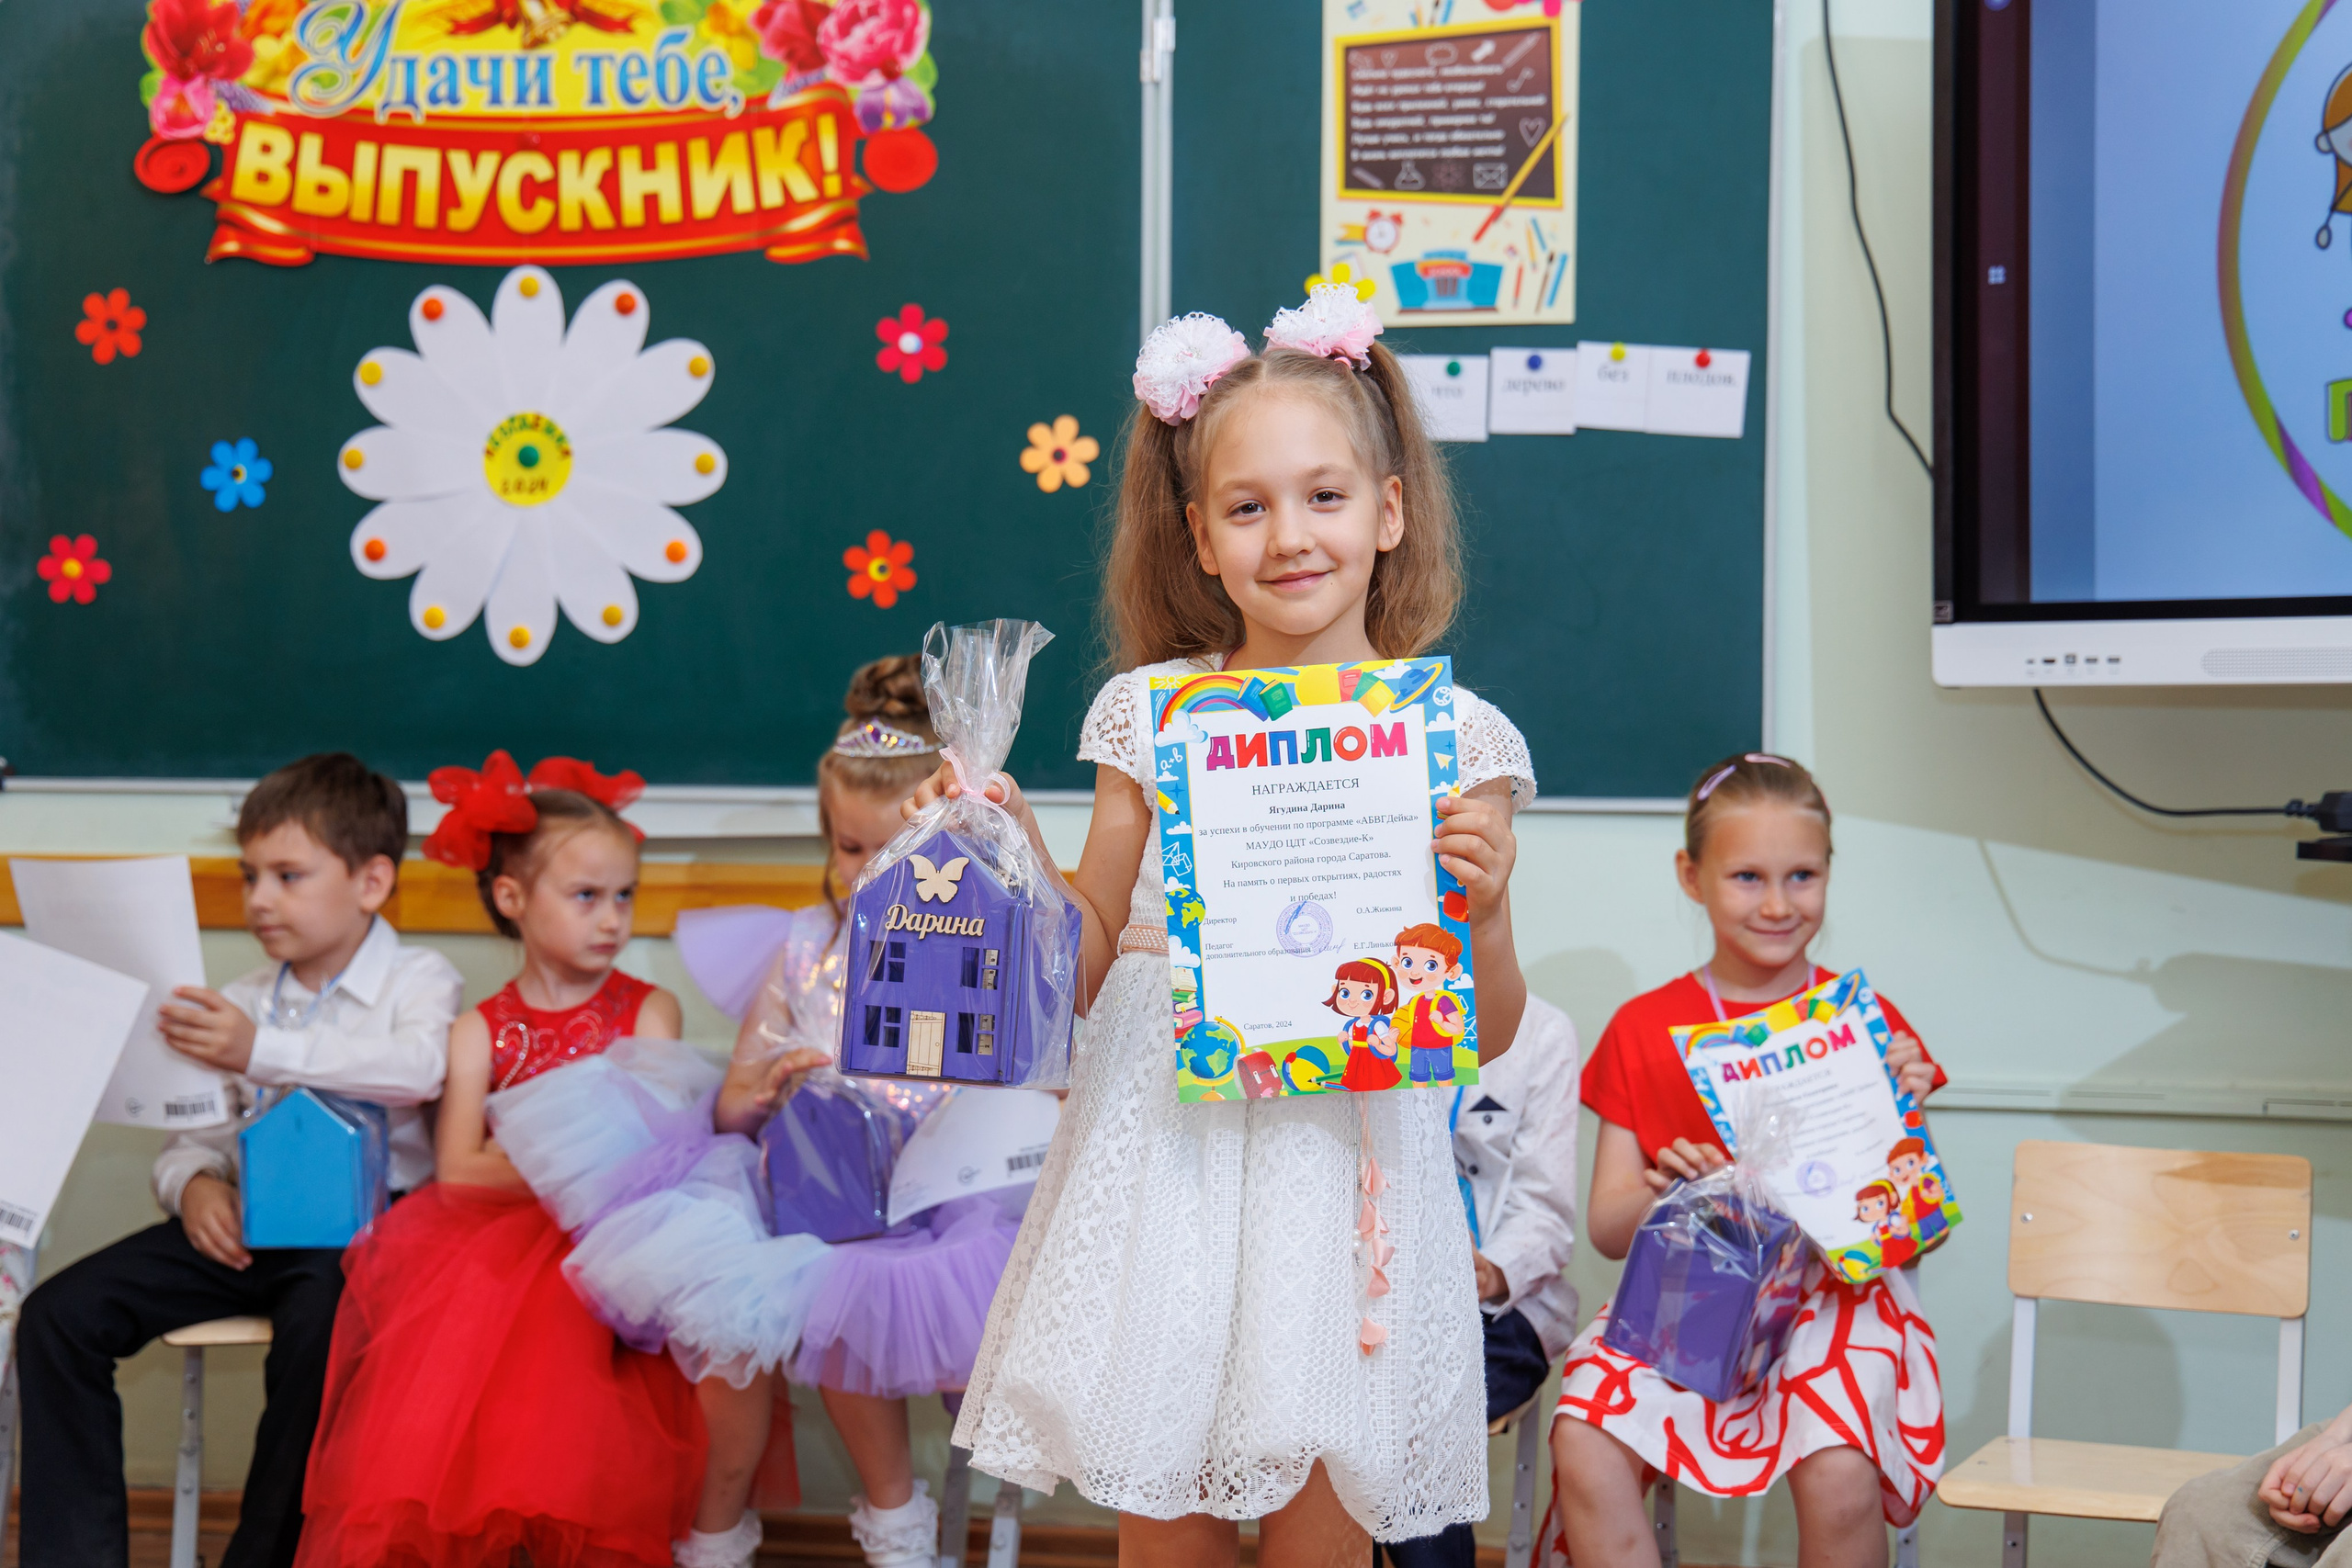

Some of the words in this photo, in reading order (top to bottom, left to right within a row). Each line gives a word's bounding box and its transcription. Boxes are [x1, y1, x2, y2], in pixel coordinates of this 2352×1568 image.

[289, 0, 555, 124] Удачи
[574, 26, 744, 118] тебе,
[231, 113, 842, 233] ВЫПУСКНИК!
[1598, 365, 1628, 383] без
[1206, 721, 1408, 771] ДИПЛОМ
[1251, 778, 1360, 795] НАГРАЖДАЕТСЯ
[1269, 804, 1308, 815] Ягудина
[1310, 801, 1346, 813] Дарина
[1198, 829, 1207, 837] за
[1209, 826, 1240, 837] успехи
[1250, 822, 1291, 834] обучении
[1293, 822, 1305, 830] по
[1306, 818, 1353, 831] программе
[1356, 814, 1419, 826] «АБВГДейка»
[1246, 840, 1283, 851] МАУДО
[1285, 838, 1306, 850] ЦДТ
[1308, 833, 1374, 847] «Созвездие-К»
[1231, 856, 1283, 870] Кировского
[1283, 854, 1315, 867] района
[1317, 852, 1347, 865] города
[1349, 851, 1392, 863] Саратова.
[1223, 879, 1236, 888] На
[1237, 877, 1268, 886] память
[1277, 874, 1309, 886] первых
[1311, 870, 1362, 884] открытиях,
[1363, 868, 1402, 881] радостях
[1297, 891, 1337, 903] победах!
[1356, 905, 1403, 915] О.А.Жижина
[885, 904, 986, 940] Дарина
[1203, 916, 1238, 926] Директор
[1204, 942, 1234, 953] Педагог
[1205, 949, 1267, 961] дополнительного
[1268, 946, 1311, 958] образования
[1243, 1021, 1274, 1032] Саратов,
[1275, 1021, 1293, 1029] 2024
[1721, 1022, 1857, 1082] ДИПЛОМ
